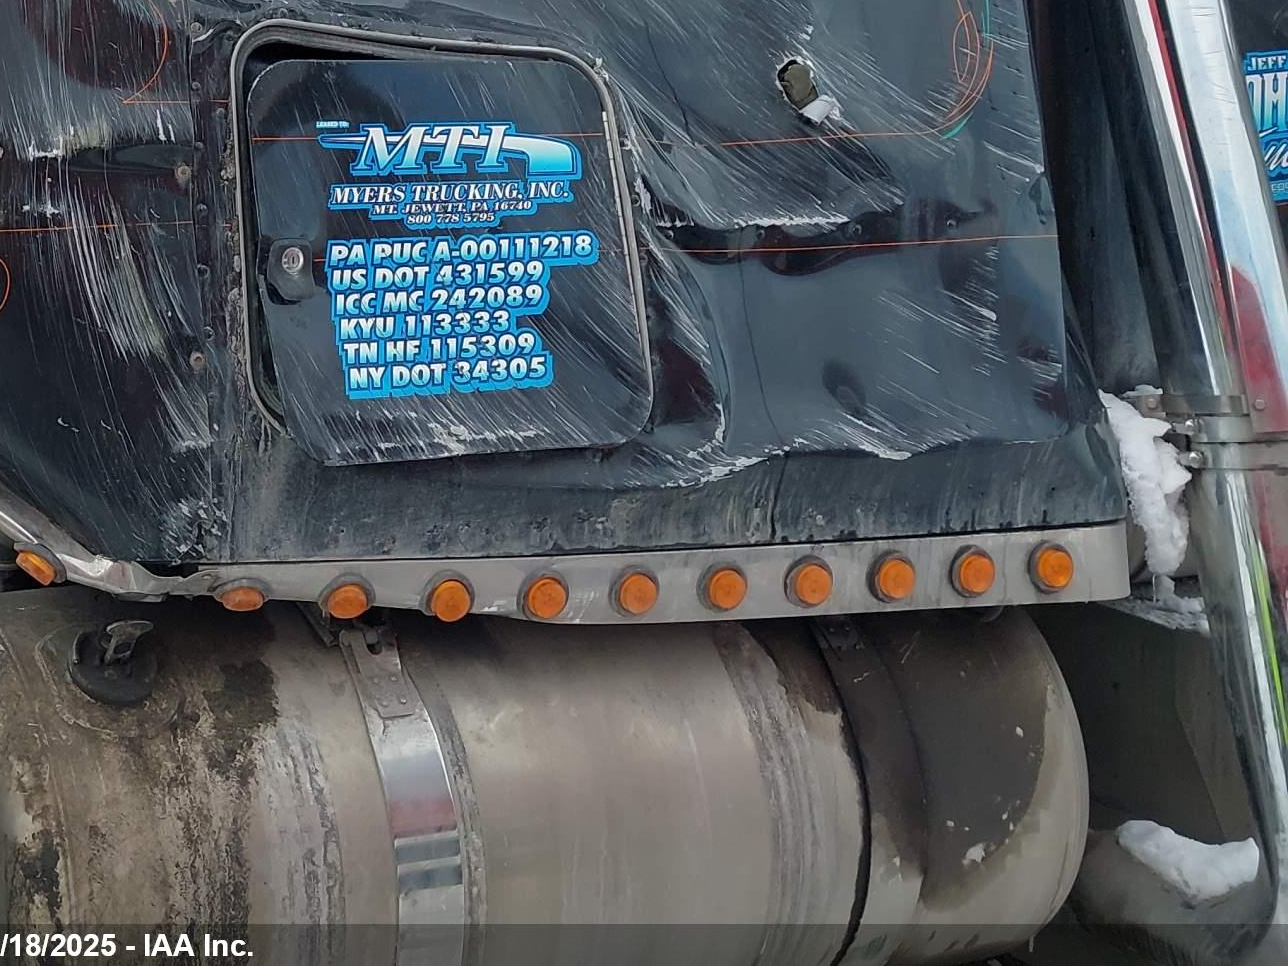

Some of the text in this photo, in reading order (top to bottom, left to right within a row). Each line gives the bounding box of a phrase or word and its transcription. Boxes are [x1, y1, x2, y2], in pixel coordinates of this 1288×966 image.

[351, 123, 513, 174] MTI
[330, 181, 569, 205] MYERS TRUCKING, INC.
[371, 200, 532, 215] MT. JEWETT, PA 16740
[406, 212, 495, 224] 800 778 5795
[330, 234, 592, 265] PA PUC A-00111218
[331, 261, 544, 289] US DOT 431599
[335, 285, 544, 315] ICC MC 242089
[339, 310, 510, 340] KYU 113333
[343, 333, 536, 364] TN HF 115309
[349, 356, 547, 389] NY DOT 34305
